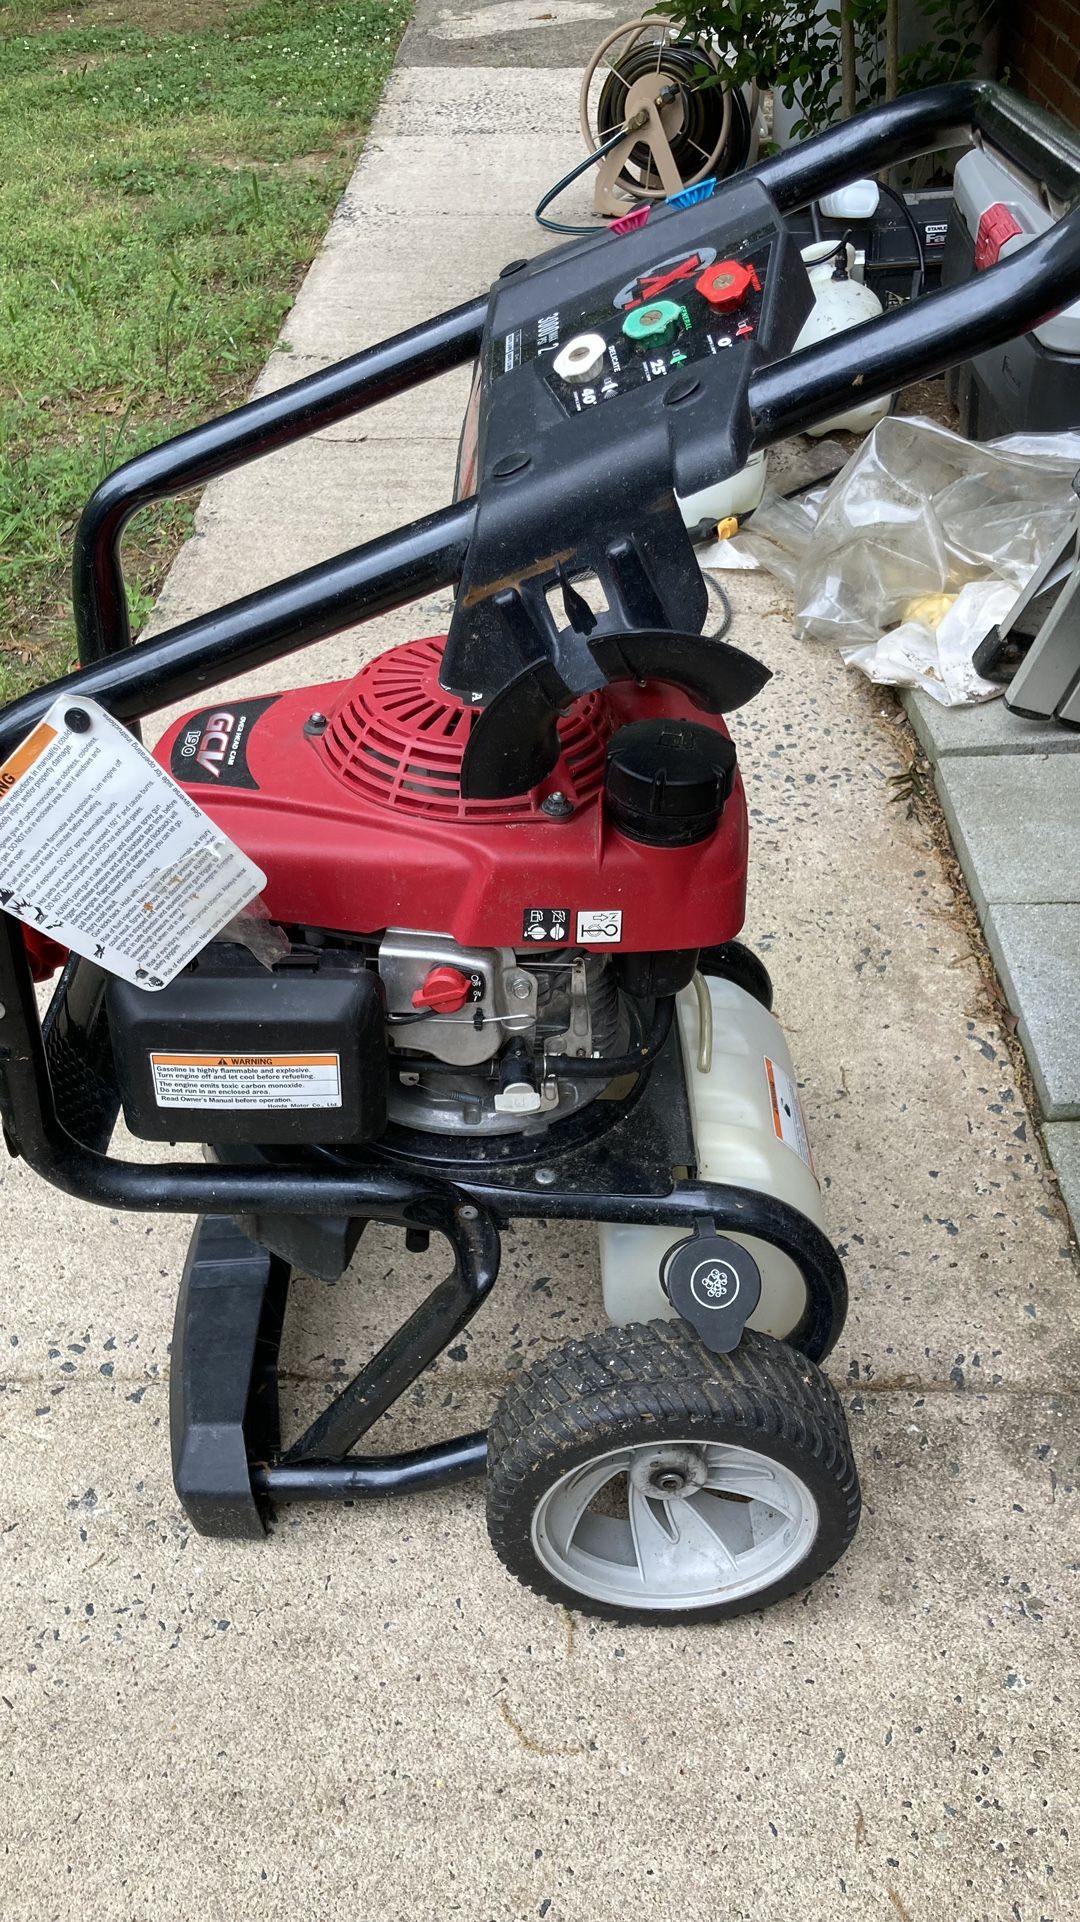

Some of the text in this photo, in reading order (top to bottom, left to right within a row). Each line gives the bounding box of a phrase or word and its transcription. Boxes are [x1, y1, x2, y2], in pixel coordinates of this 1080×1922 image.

[608, 345, 620, 373] DELICATE
[129, 740, 157, 769] operating
[181, 731, 201, 757] 190
[196, 712, 235, 778] GCV
[228, 716, 246, 766] OVER HEAD CAM
[7, 841, 18, 852] DO
[14, 831, 26, 844] NOT
[24, 825, 33, 835] run
[34, 802, 53, 823] enclosed
[61, 780, 74, 793] even
[72, 756, 93, 778] windows
[89, 746, 102, 759] and
[33, 764, 55, 789] property
[152, 766, 163, 778] for
[160, 774, 174, 789] side
[171, 786, 192, 807] reverse
[6, 875, 18, 887] Fuel
[15, 867, 26, 878] and
[41, 841, 49, 850] are
[46, 819, 68, 844] flammable
[65, 812, 76, 822] and
[90, 780, 104, 794] Turn
[100, 765, 118, 784] engine
[113, 758, 123, 768] off
[9, 825, 21, 838] give
[16, 818, 25, 828] off
[21, 805, 38, 822] carbon
[54, 777, 62, 786] an
[189, 805, 201, 818] See
[15, 881, 25, 892] and
[22, 875, 30, 884] let
[30, 864, 41, 875] cool
[55, 830, 72, 849] minutes
[68, 816, 84, 833] before
[25, 887, 37, 899] Risk
[33, 882, 41, 890] of
[56, 855, 66, 866] DO
[63, 846, 75, 858] NOT
[73, 835, 87, 850] spray
[82, 813, 105, 837] flammable
[44, 886, 57, 899] parts
[53, 878, 63, 888] and
[60, 862, 78, 880] exhaust
[75, 850, 90, 866] gases
[86, 842, 97, 853] can
[93, 827, 110, 845] exceed
[119, 804, 131, 816] and
[128, 792, 142, 807] cause
[44, 901, 54, 911] DO
[51, 891, 63, 904] NOT
[60, 880, 73, 894] touch
[70, 873, 80, 883] hot
[77, 863, 90, 877] parts
[86, 855, 97, 866] and
[94, 841, 110, 858] AVOID
[106, 834, 116, 844] hot
[113, 818, 131, 837] exhaust
[54, 896, 74, 917] ALWAYS
[80, 879, 91, 890] gun
[87, 874, 95, 882] in
[91, 865, 103, 878] safe
[100, 849, 119, 869] direction
[115, 840, 126, 852] and
[123, 823, 143, 844] squeeze
[139, 812, 154, 827] spray
[150, 803, 162, 815] gun
